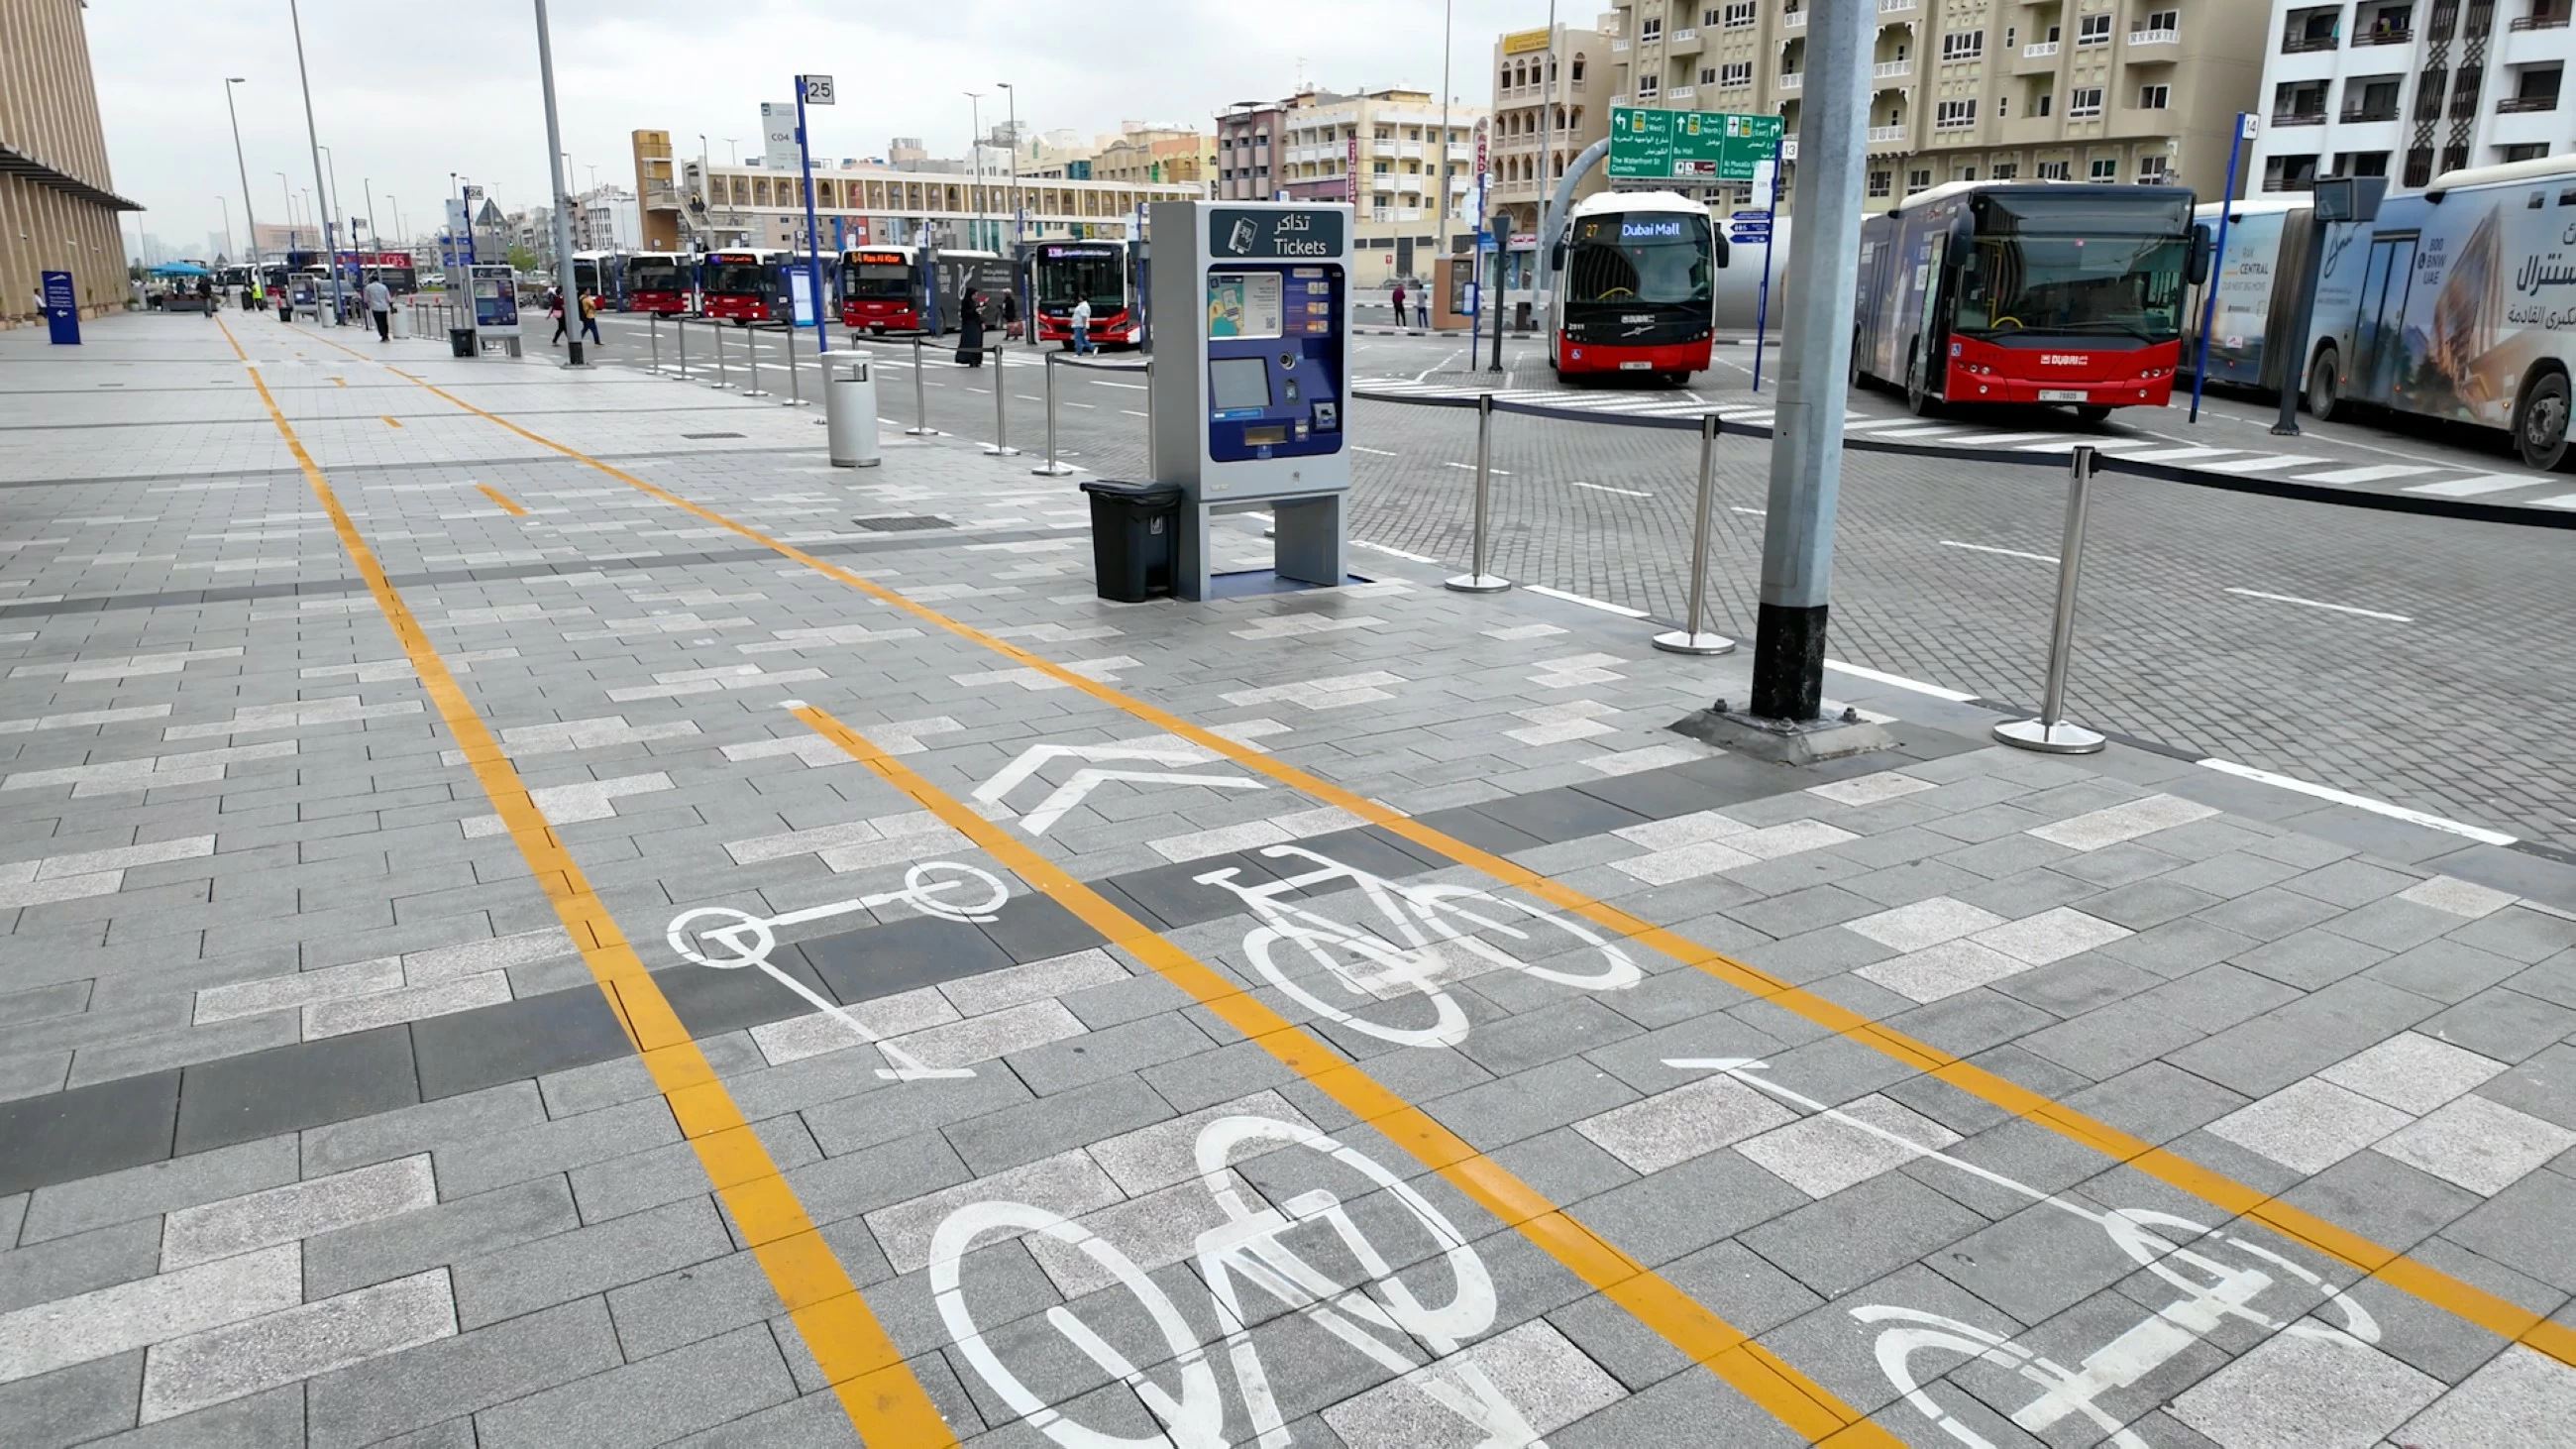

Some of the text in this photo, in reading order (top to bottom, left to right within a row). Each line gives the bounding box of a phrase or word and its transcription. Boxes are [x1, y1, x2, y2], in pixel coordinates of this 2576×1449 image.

[809, 82, 831, 97] 25
[2246, 120, 2257, 132] 14
[1784, 145, 1795, 156] 13
[1273, 213, 1311, 235] تذاكر
[1586, 224, 1599, 238] 27
[1622, 222, 1680, 236] Dubai Mall
[1273, 238, 1328, 255] Tickets
[2239, 263, 2269, 275] CENTRAL
